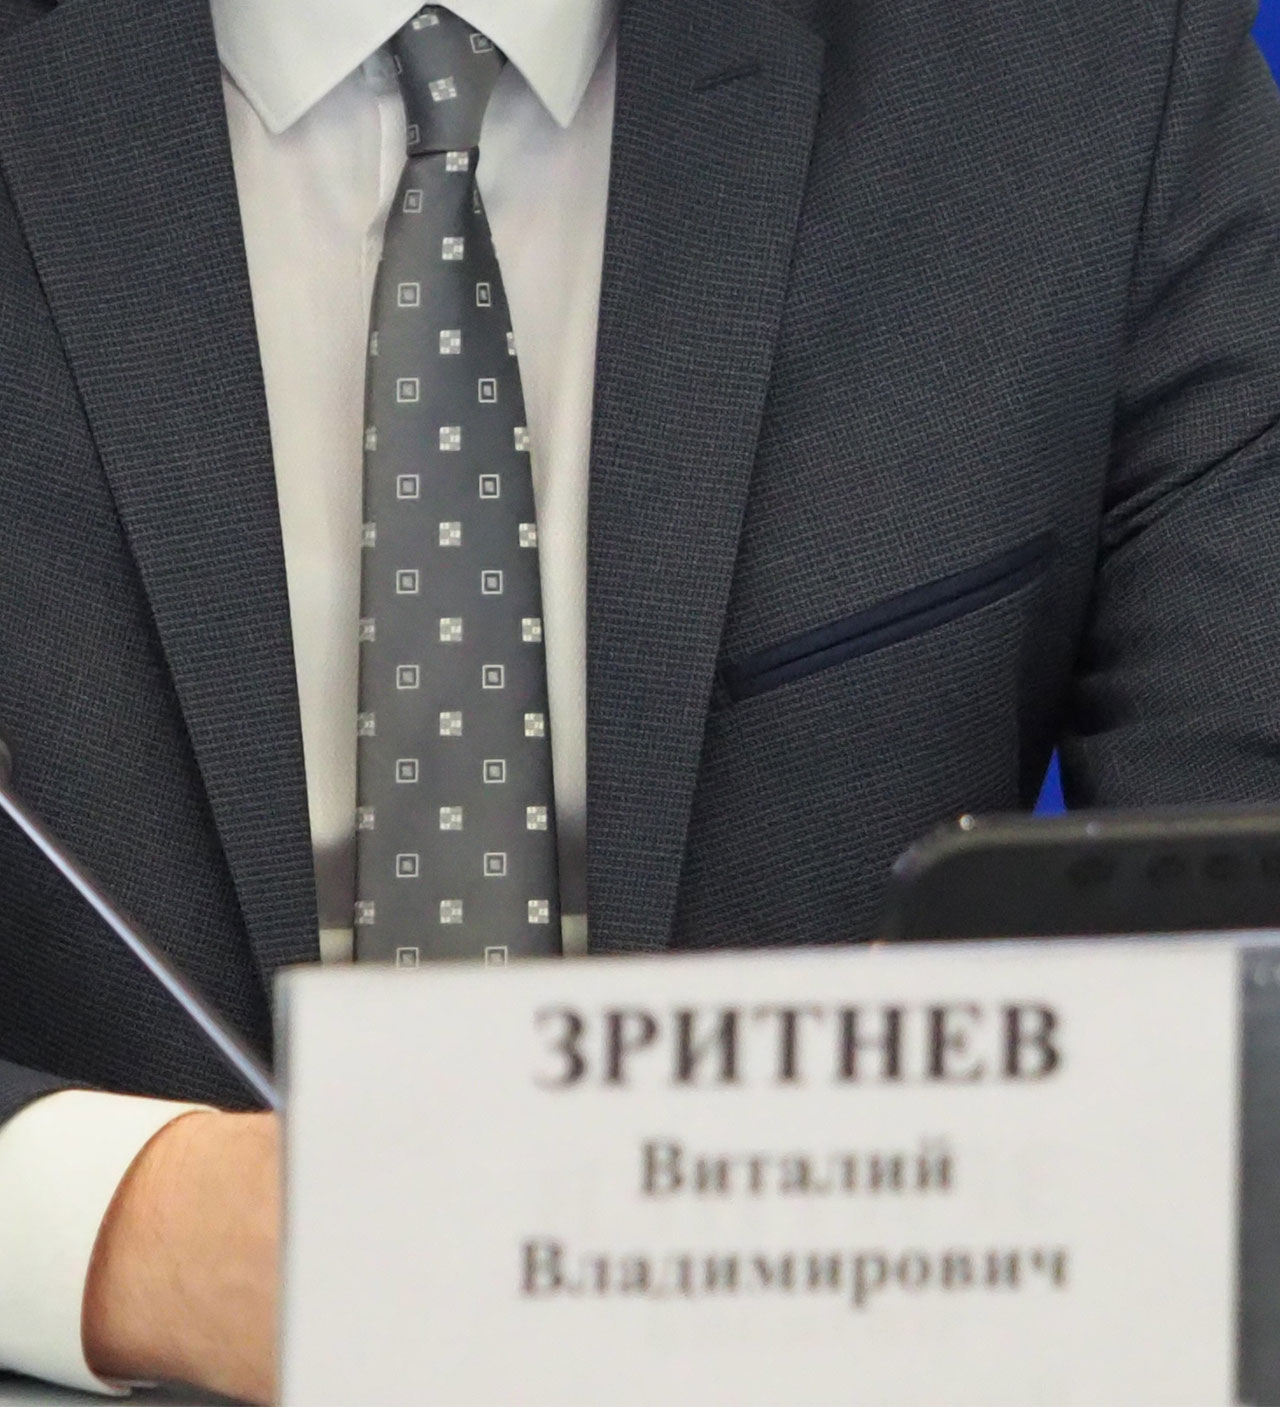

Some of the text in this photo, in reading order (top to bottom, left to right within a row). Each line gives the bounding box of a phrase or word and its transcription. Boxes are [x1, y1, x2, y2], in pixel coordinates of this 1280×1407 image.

[533, 1001, 1063, 1089] ЗРИТНЕВ
[639, 1134, 955, 1198] Виталий
[520, 1238, 1069, 1309] Владимирович
